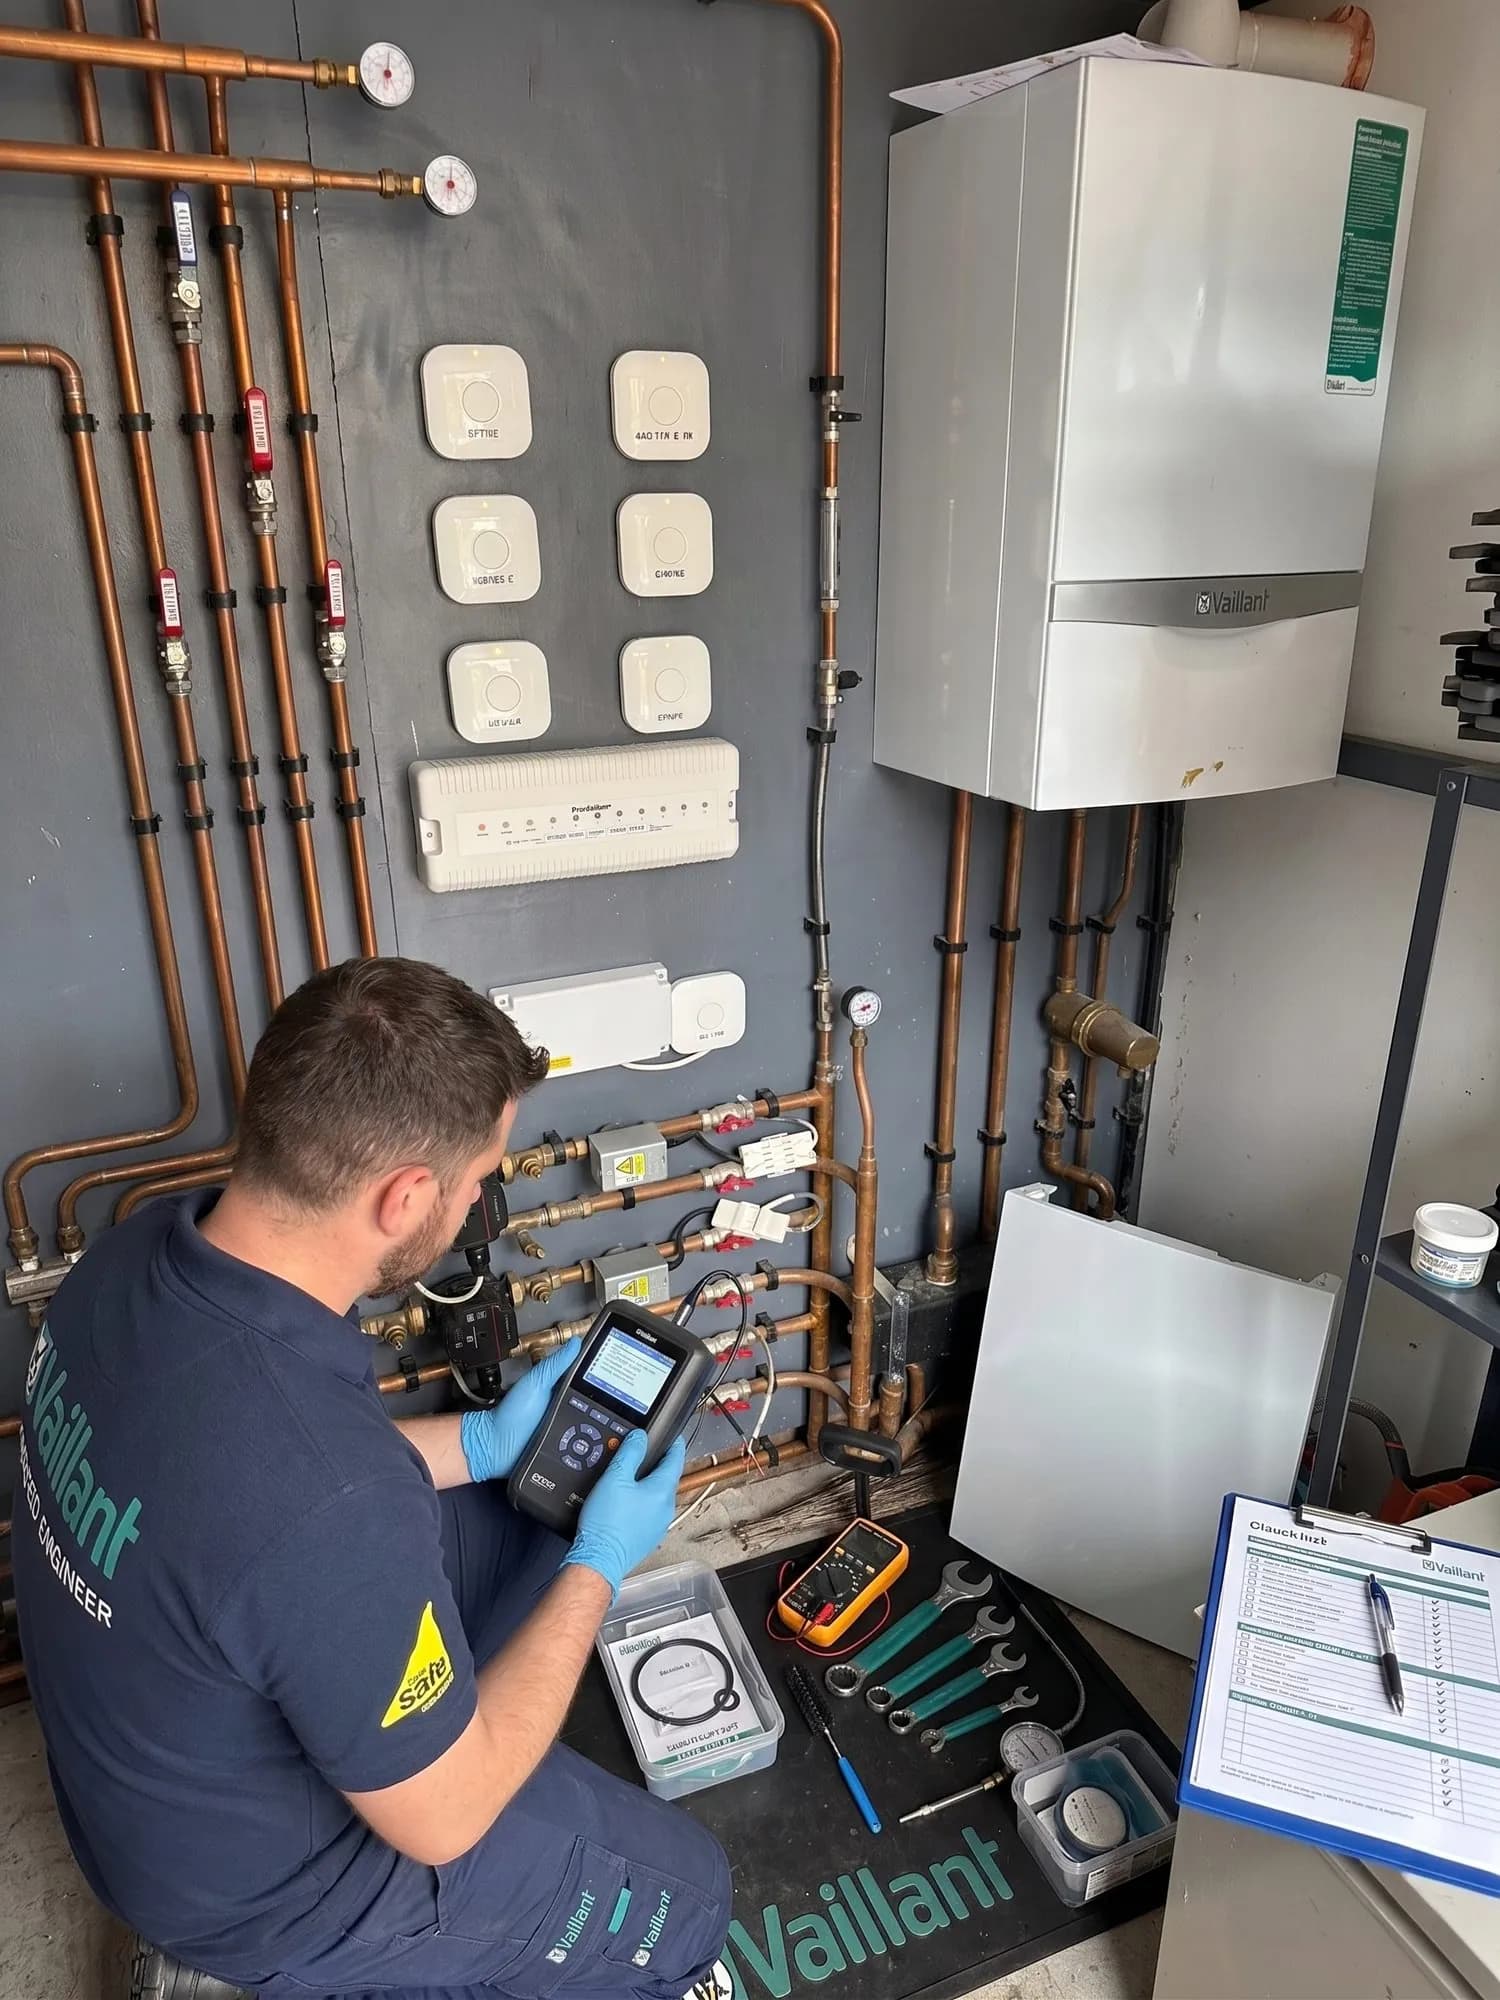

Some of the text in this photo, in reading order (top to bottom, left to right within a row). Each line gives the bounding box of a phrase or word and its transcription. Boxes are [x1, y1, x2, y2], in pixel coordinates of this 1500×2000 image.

[1212, 588, 1270, 614] Vaillant
[32, 1348, 142, 1580] Vaillant
[1434, 1561, 1486, 1582] Vaillant
[555, 1889, 596, 1949] Vaillant
[640, 1889, 672, 1949] Vaillant
[728, 1826, 1014, 1998] Vaillant
